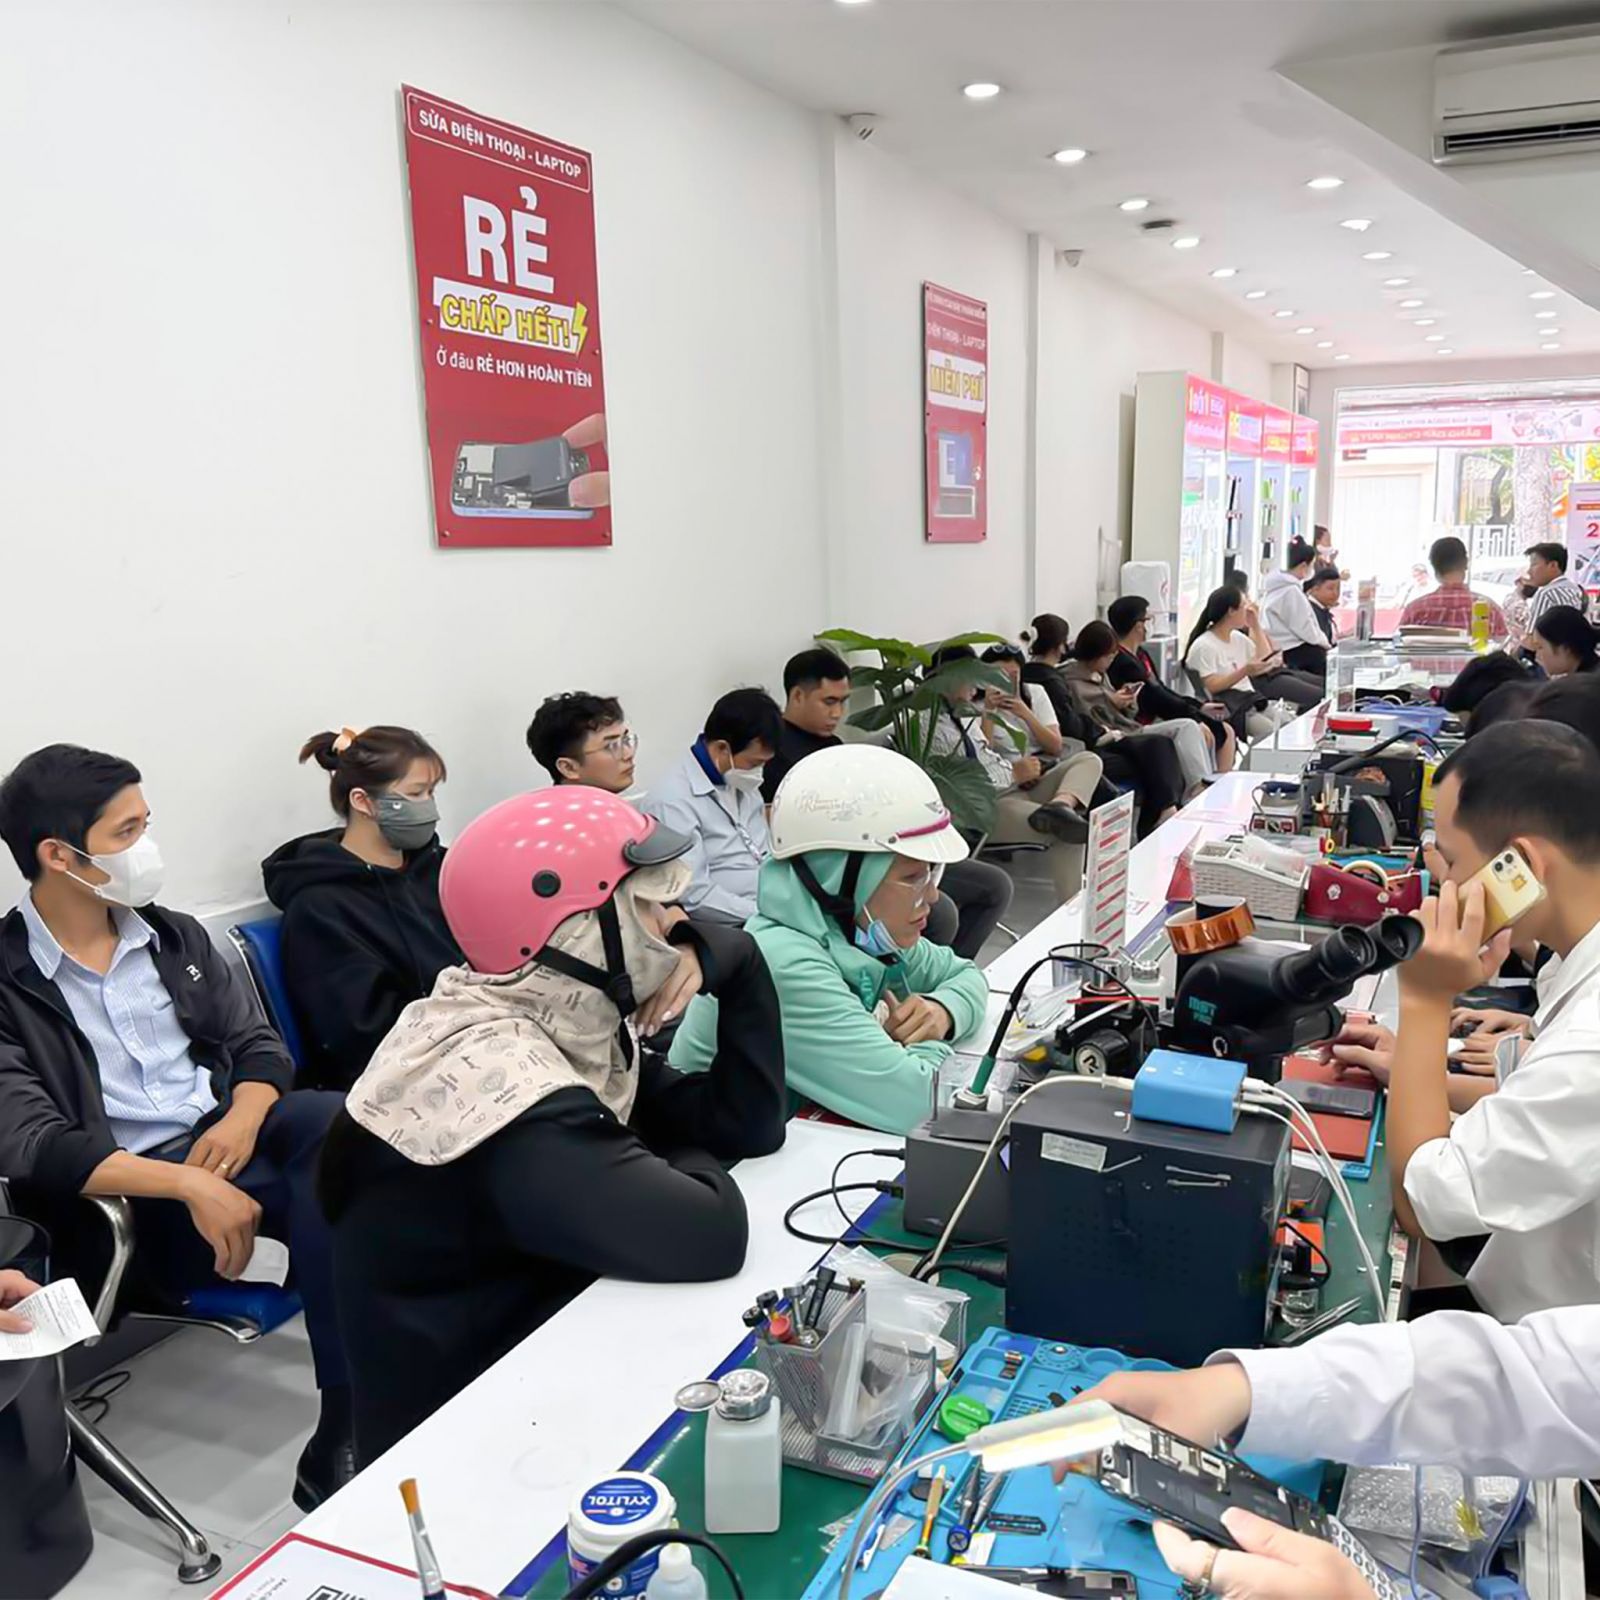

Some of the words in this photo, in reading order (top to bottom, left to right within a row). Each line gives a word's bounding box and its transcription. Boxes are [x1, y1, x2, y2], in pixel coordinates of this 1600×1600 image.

[419, 109, 449, 133] SỬA
[451, 121, 484, 146] ĐIỆN
[486, 134, 525, 162] THOẠI
[535, 152, 581, 178] LAPTOP
[463, 185, 554, 294] RẺ
[440, 293, 512, 337] CHẤP
[516, 305, 571, 348] HẾT!
[436, 345, 447, 366] Ở
[450, 351, 474, 370] đâu
[476, 352, 494, 373] RẺ
[496, 356, 525, 378] HƠN
[527, 362, 563, 384] HOÀN
[566, 368, 593, 388] TIỀN
[588, 1495, 652, 1506] XYLITOL
